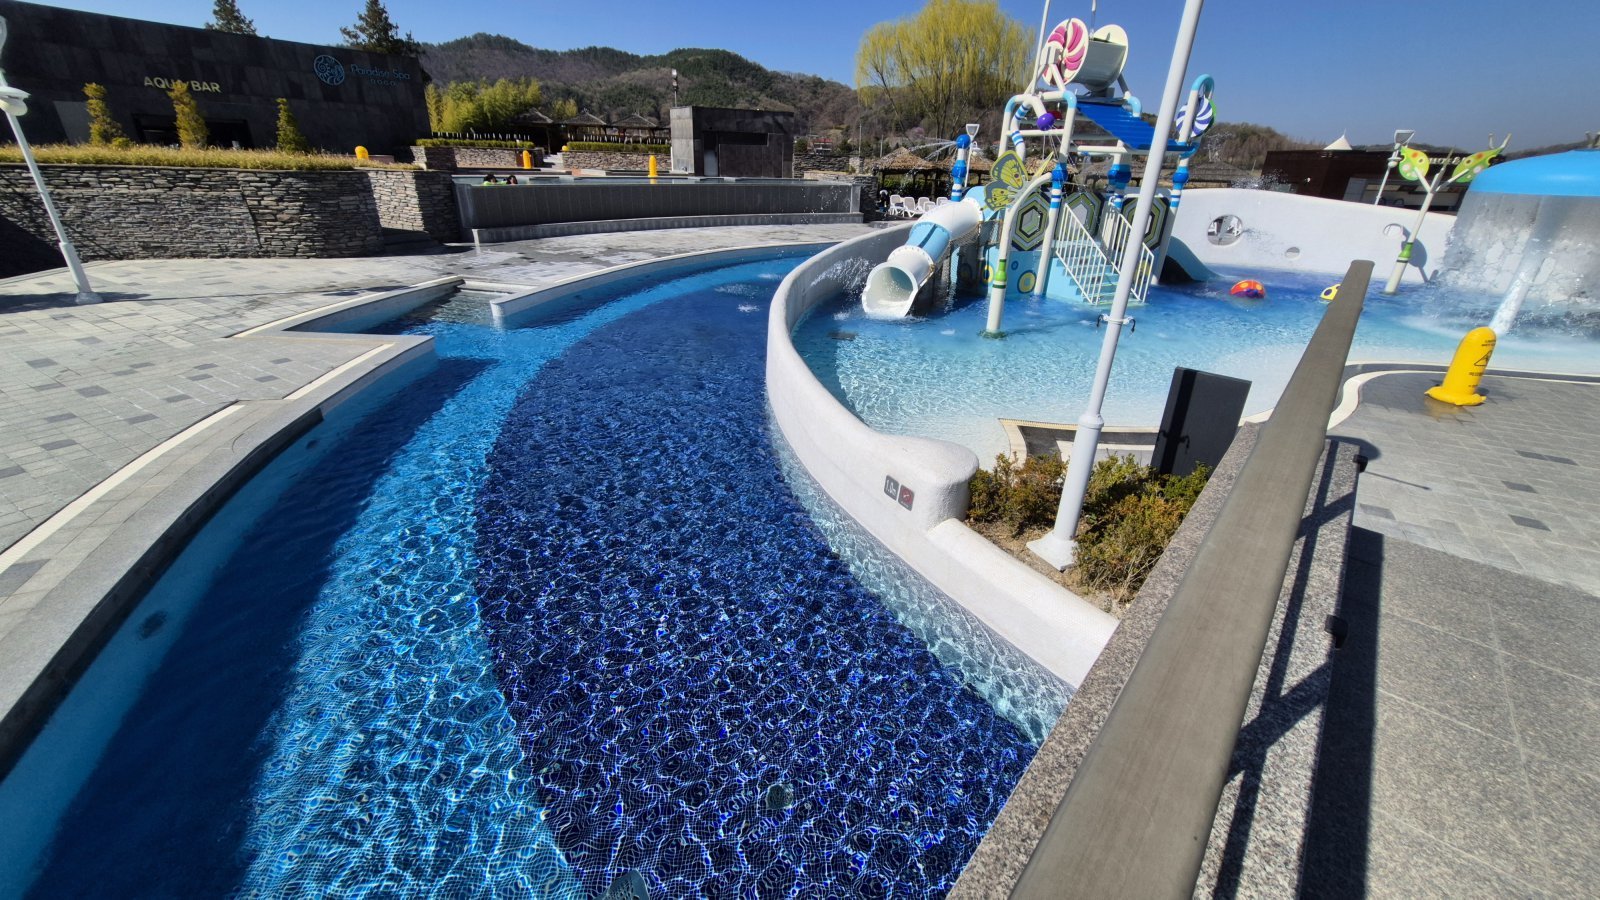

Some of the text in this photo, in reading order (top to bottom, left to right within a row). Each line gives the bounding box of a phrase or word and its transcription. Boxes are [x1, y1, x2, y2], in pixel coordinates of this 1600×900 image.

[350, 63, 411, 81] Paradise Spa
[144, 76, 221, 93] AQU BAR
